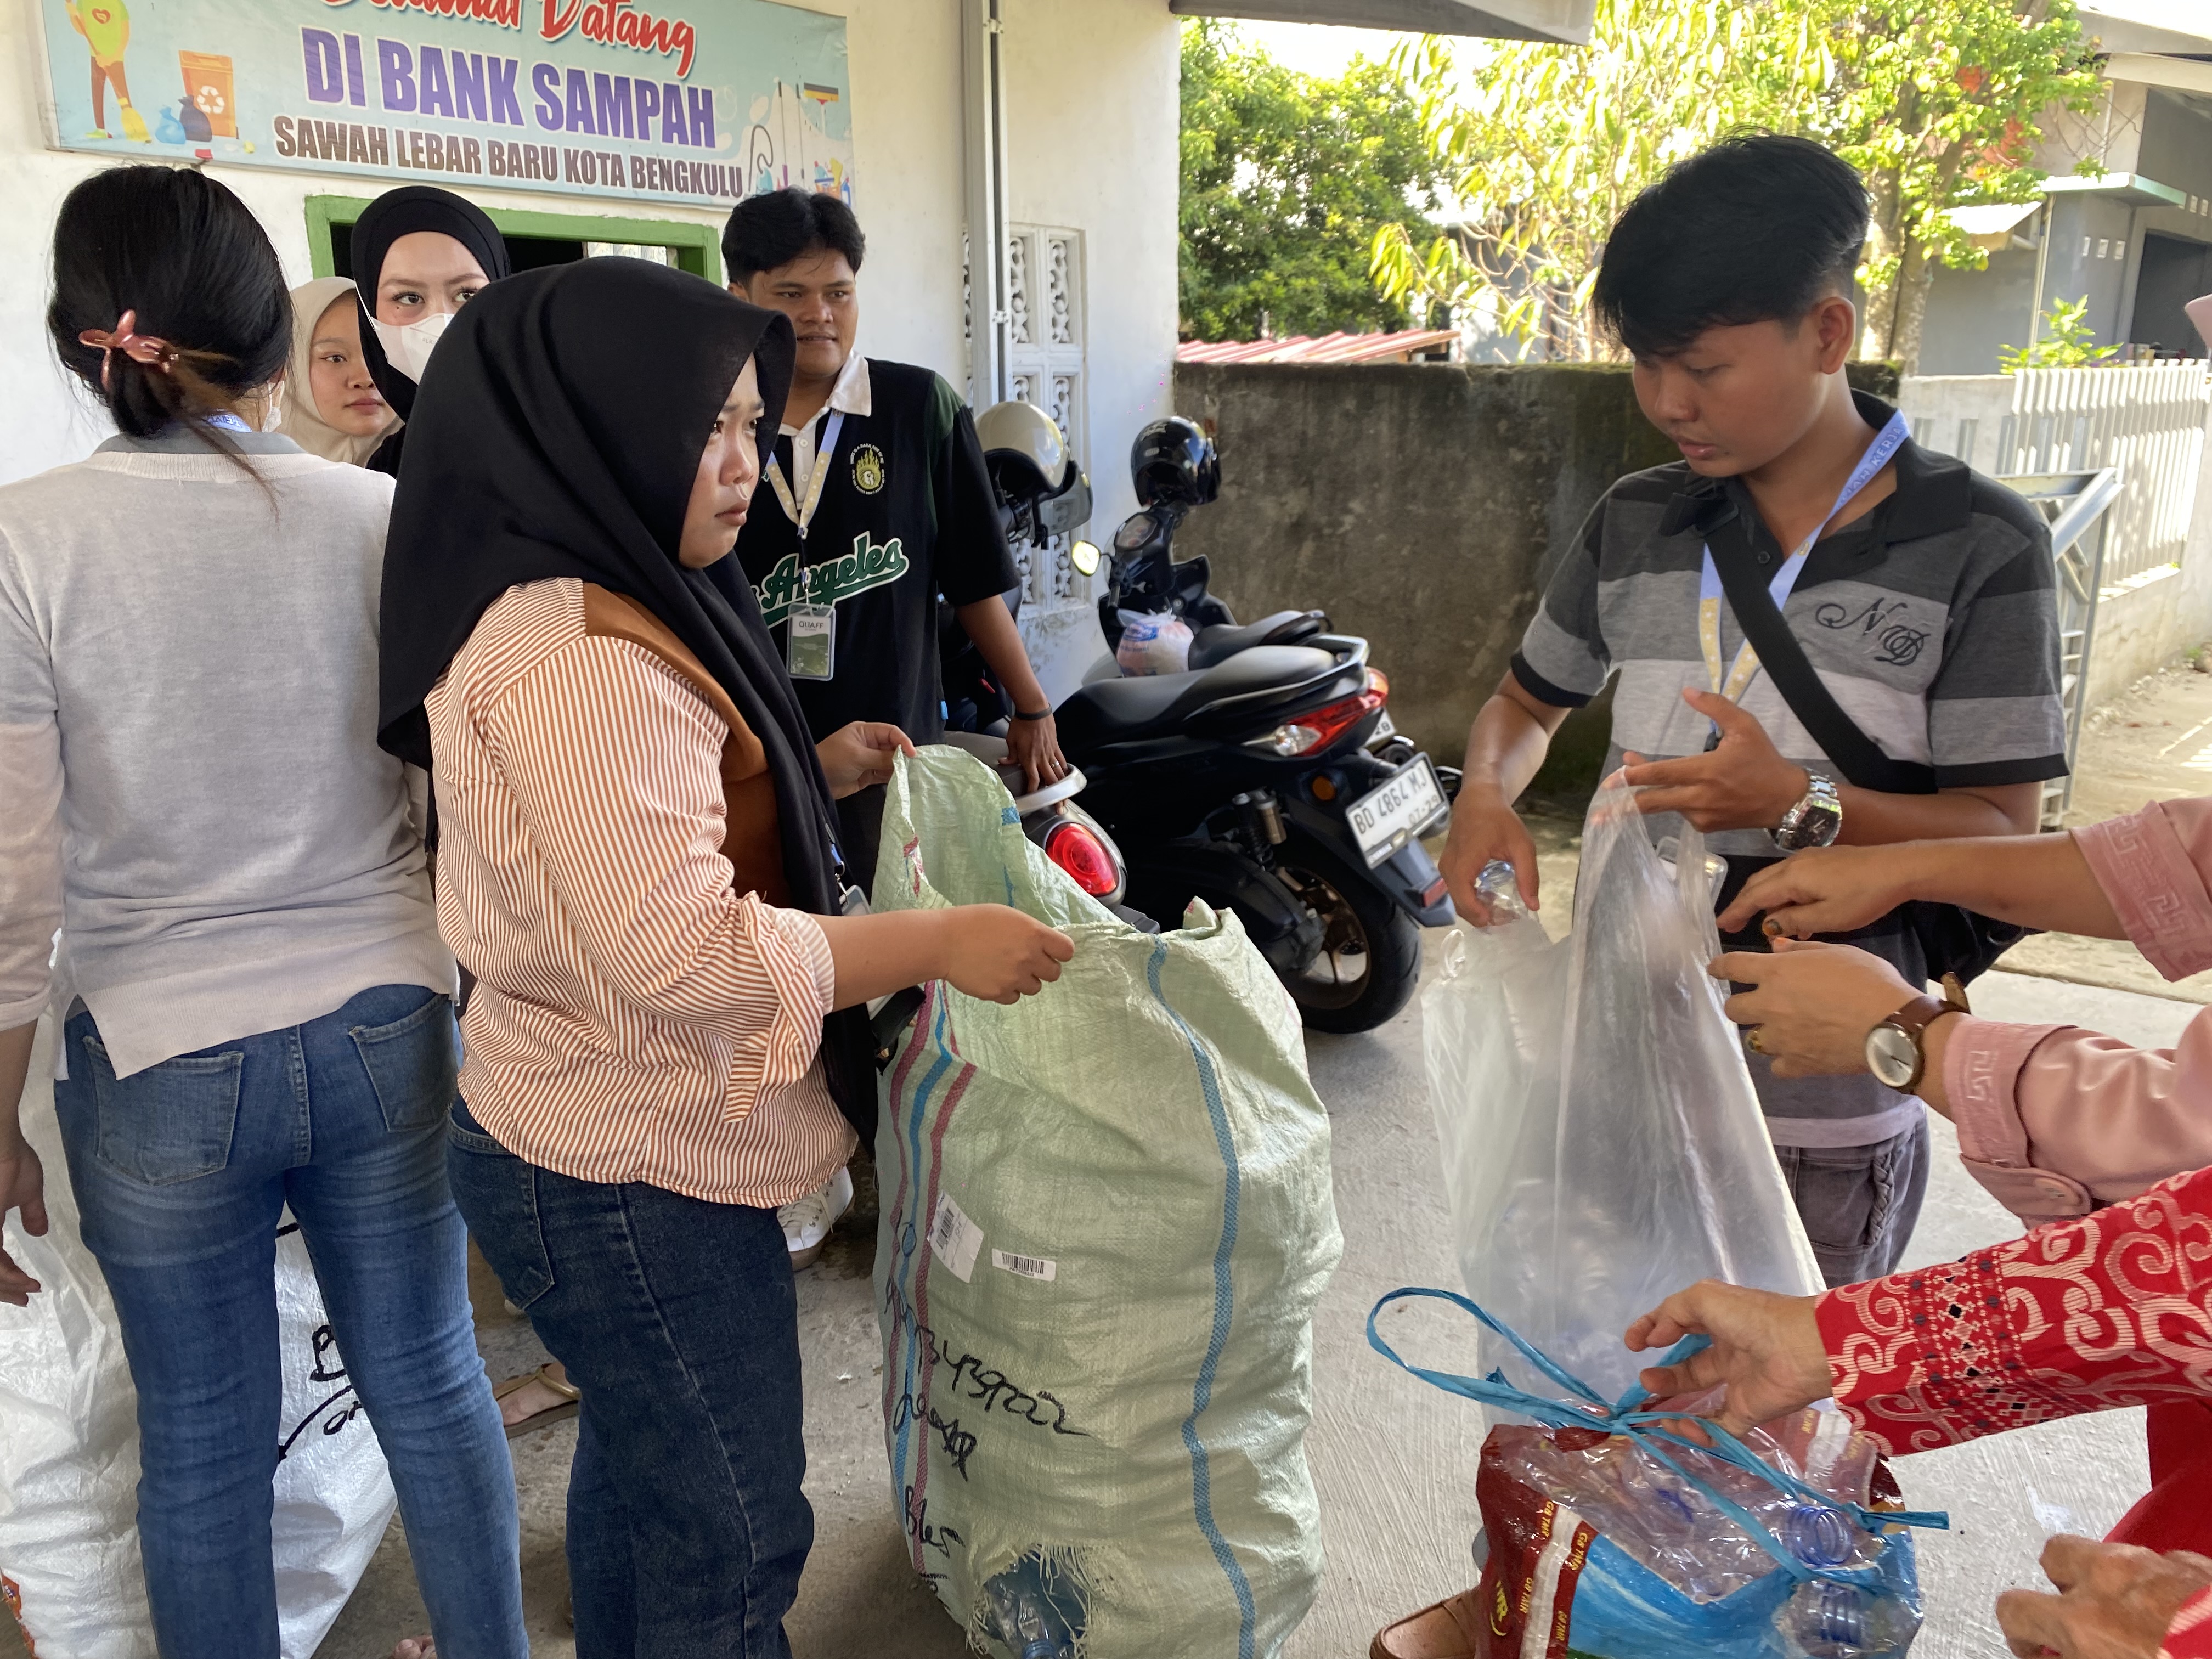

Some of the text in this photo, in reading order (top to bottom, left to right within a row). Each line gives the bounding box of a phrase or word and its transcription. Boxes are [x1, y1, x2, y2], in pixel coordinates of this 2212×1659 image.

[540, 0, 694, 77] Datang
[301, 27, 716, 148] DI BANK SAMPAH
[274, 116, 743, 199] SAWAH LEBAR BARU KOTA BENGKULU
[1870, 427, 1904, 466] KERJA
[760, 531, 910, 610] Angeles
[1353, 766, 1429, 834] BD 4864 MJ
